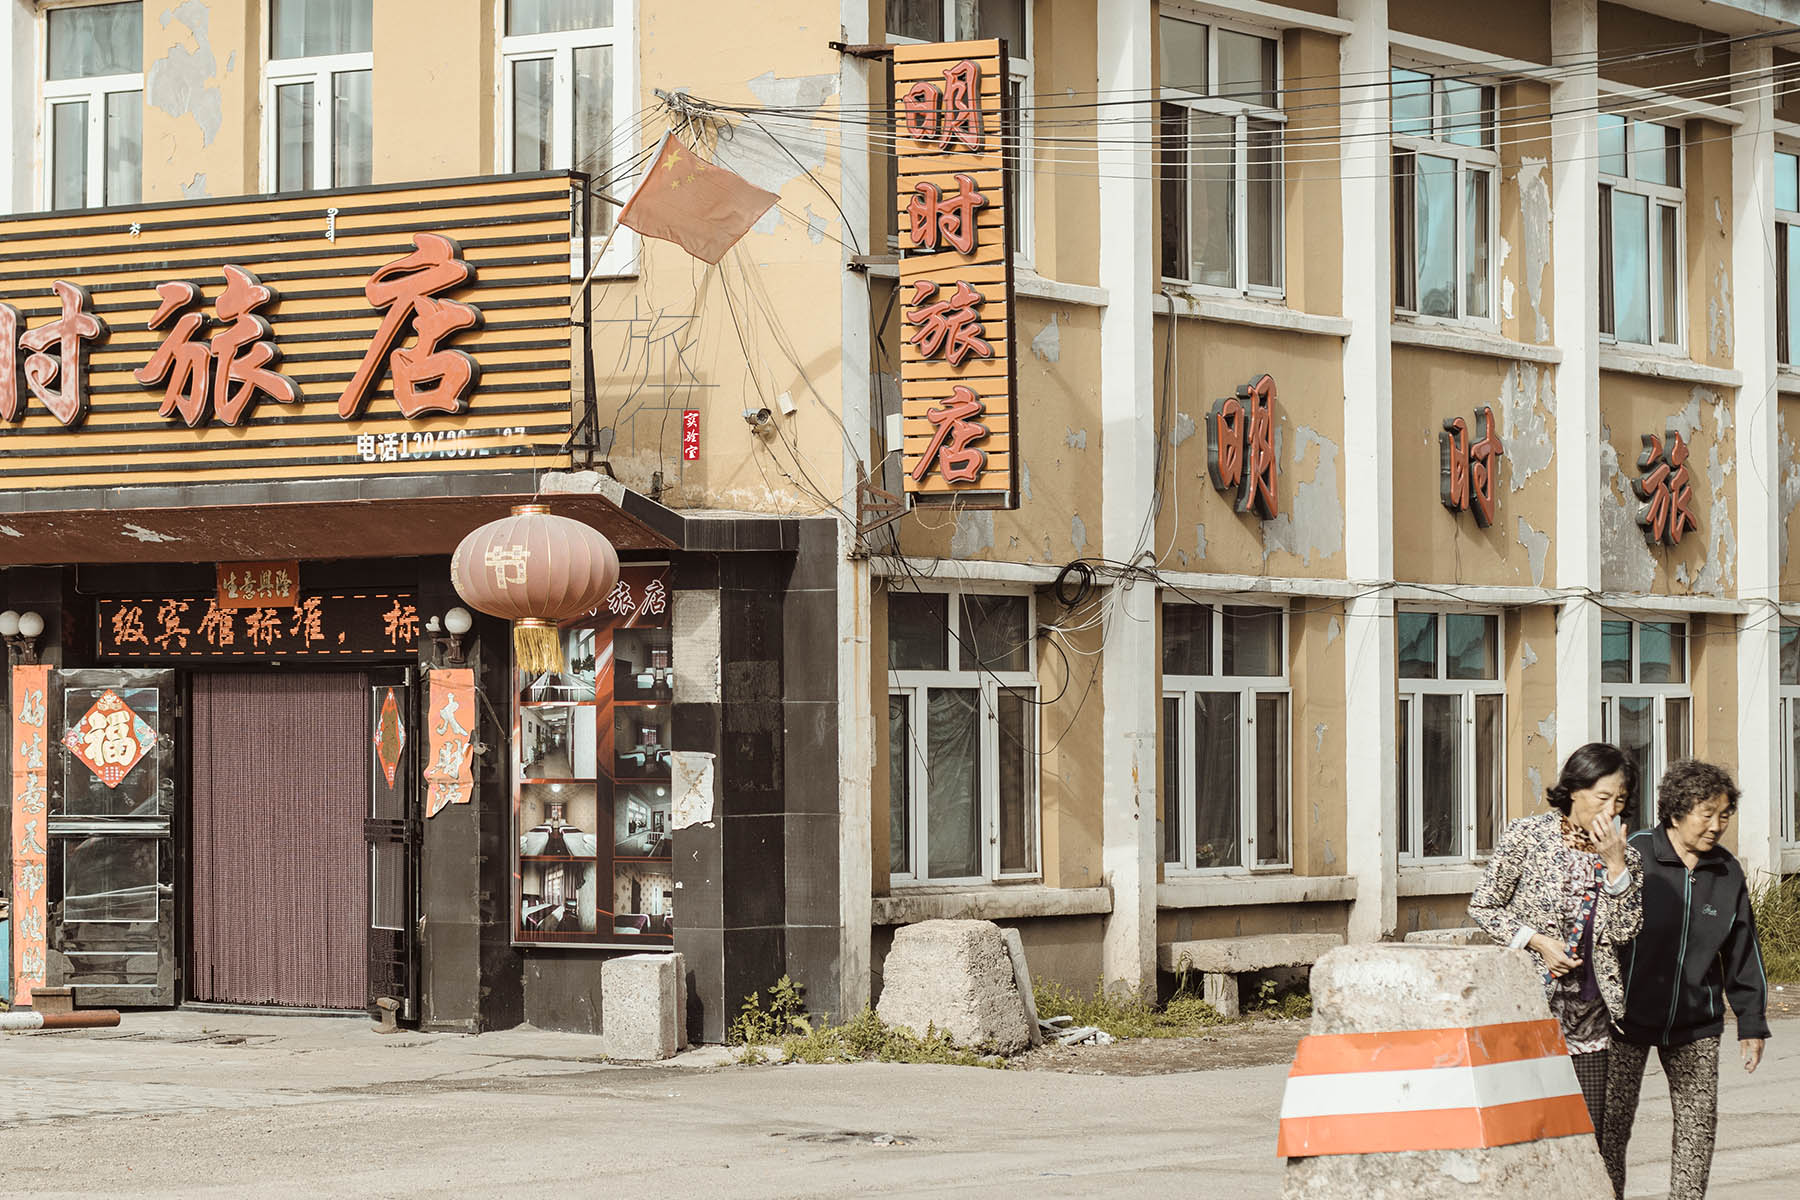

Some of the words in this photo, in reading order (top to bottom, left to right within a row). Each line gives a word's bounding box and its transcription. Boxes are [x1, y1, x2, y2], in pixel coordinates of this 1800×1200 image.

[903, 59, 993, 483] 明时旅店
[1208, 374, 1279, 520] 明
[1441, 407, 1504, 528] 时
[1633, 430, 1697, 545] 旅
[84, 710, 137, 767] 福
